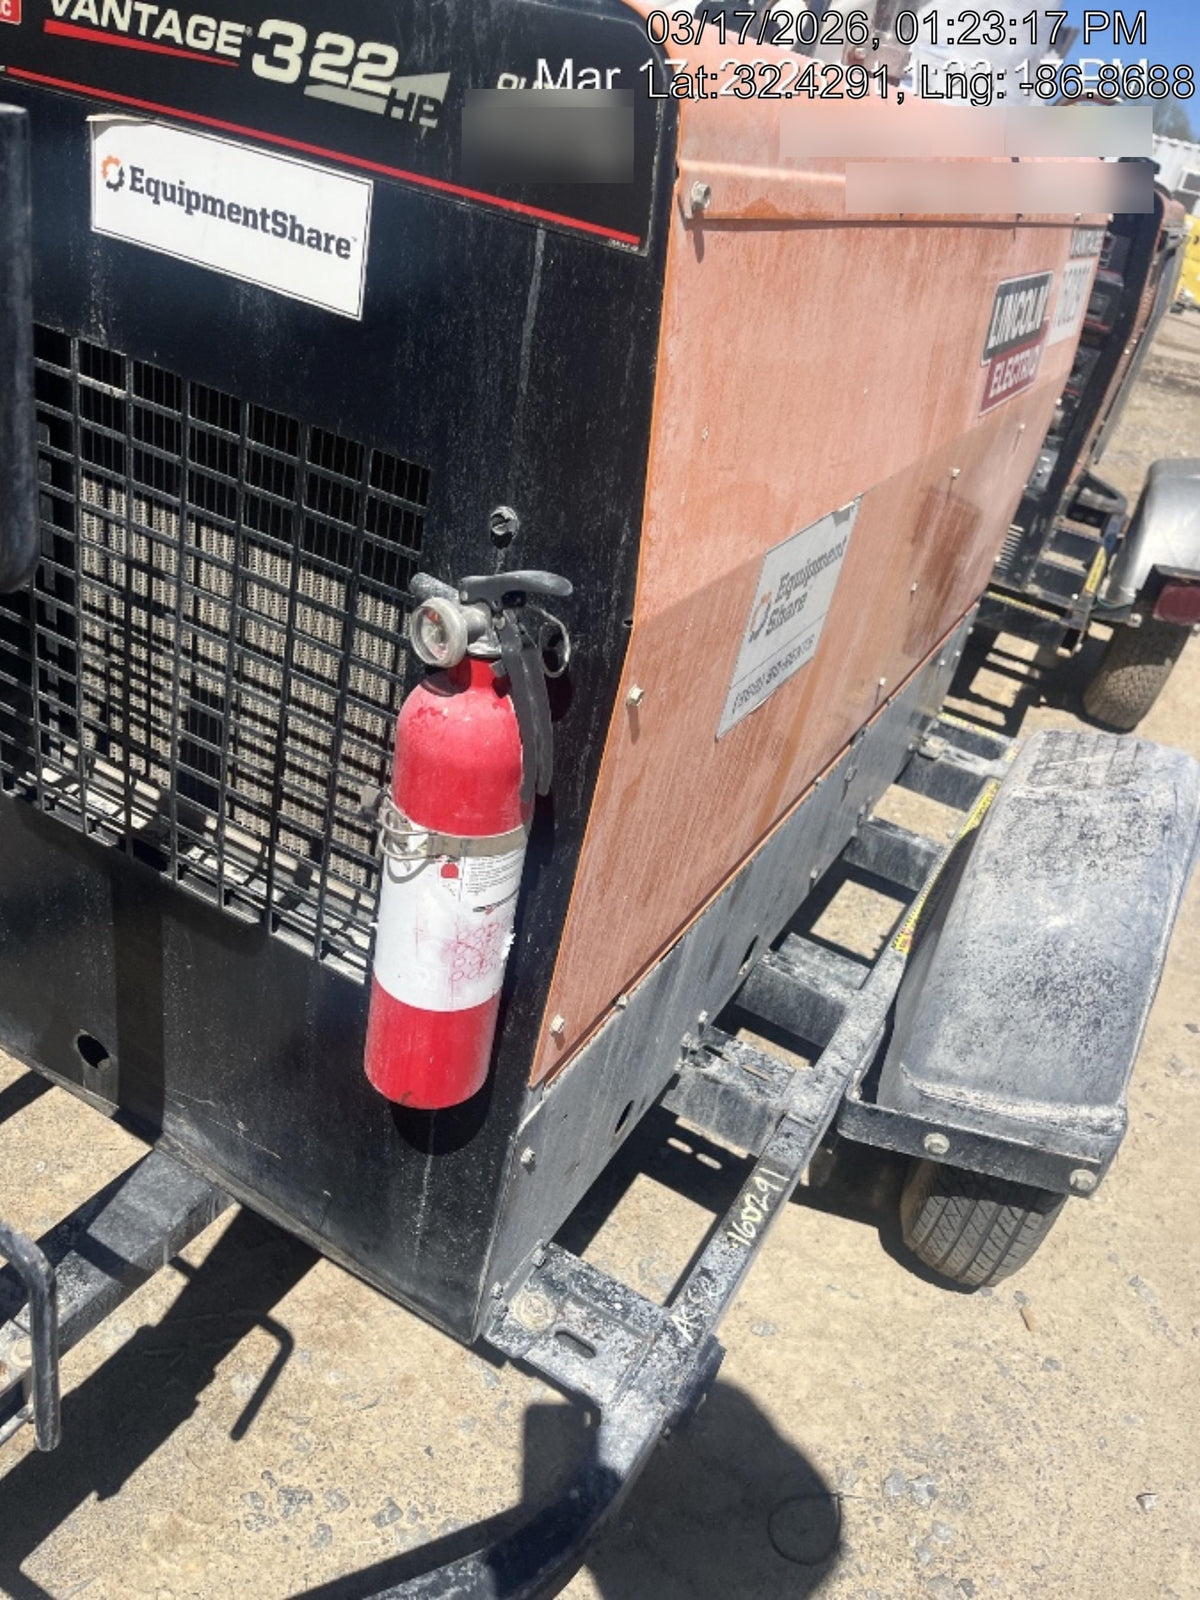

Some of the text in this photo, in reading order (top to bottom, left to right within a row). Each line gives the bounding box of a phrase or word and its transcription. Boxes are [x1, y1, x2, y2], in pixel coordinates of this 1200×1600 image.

[252, 19, 399, 96] 322
[129, 165, 353, 260] EquipmentShare
[987, 284, 1049, 350] LINCOLN
[774, 535, 848, 604] Equipment
